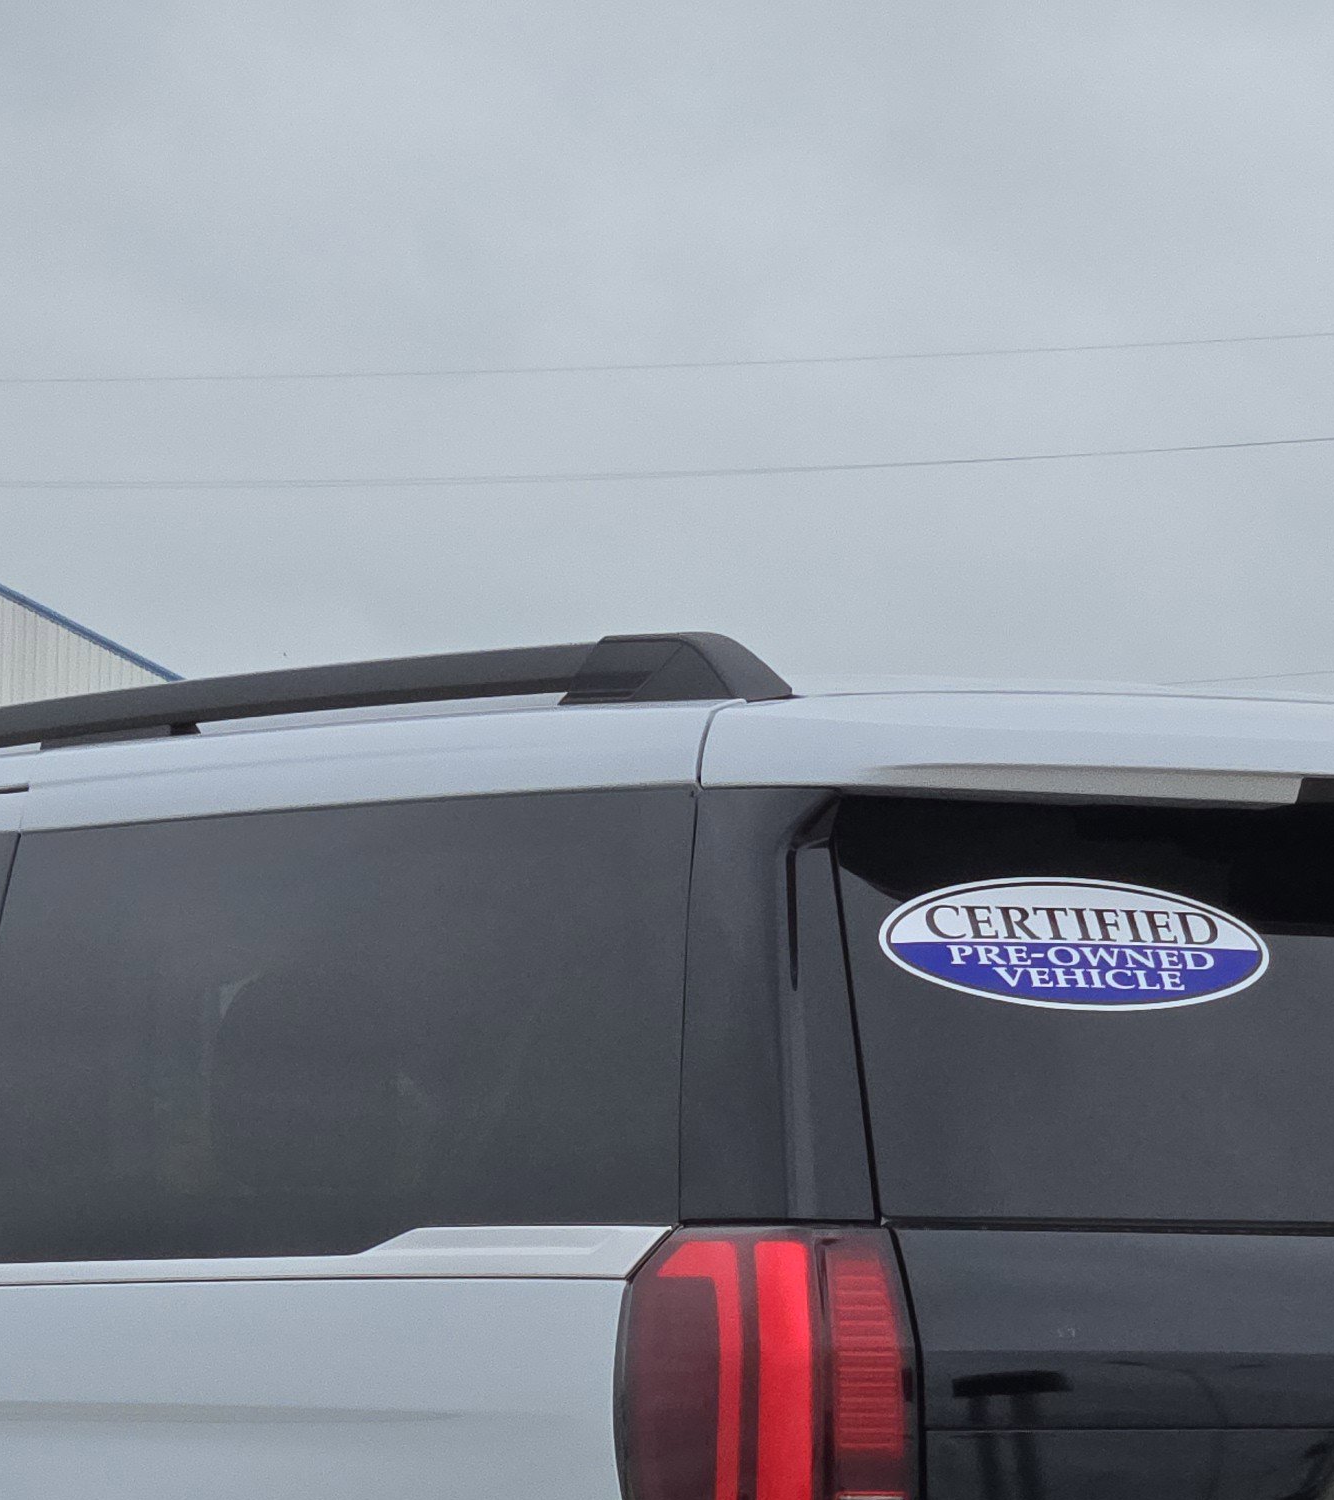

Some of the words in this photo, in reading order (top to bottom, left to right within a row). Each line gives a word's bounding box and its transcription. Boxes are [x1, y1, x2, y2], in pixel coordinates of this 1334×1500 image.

[925, 905, 1219, 946] CERTIFIED
[946, 945, 1215, 971] PRE-OWNED
[992, 966, 1186, 991] VEHICLE
